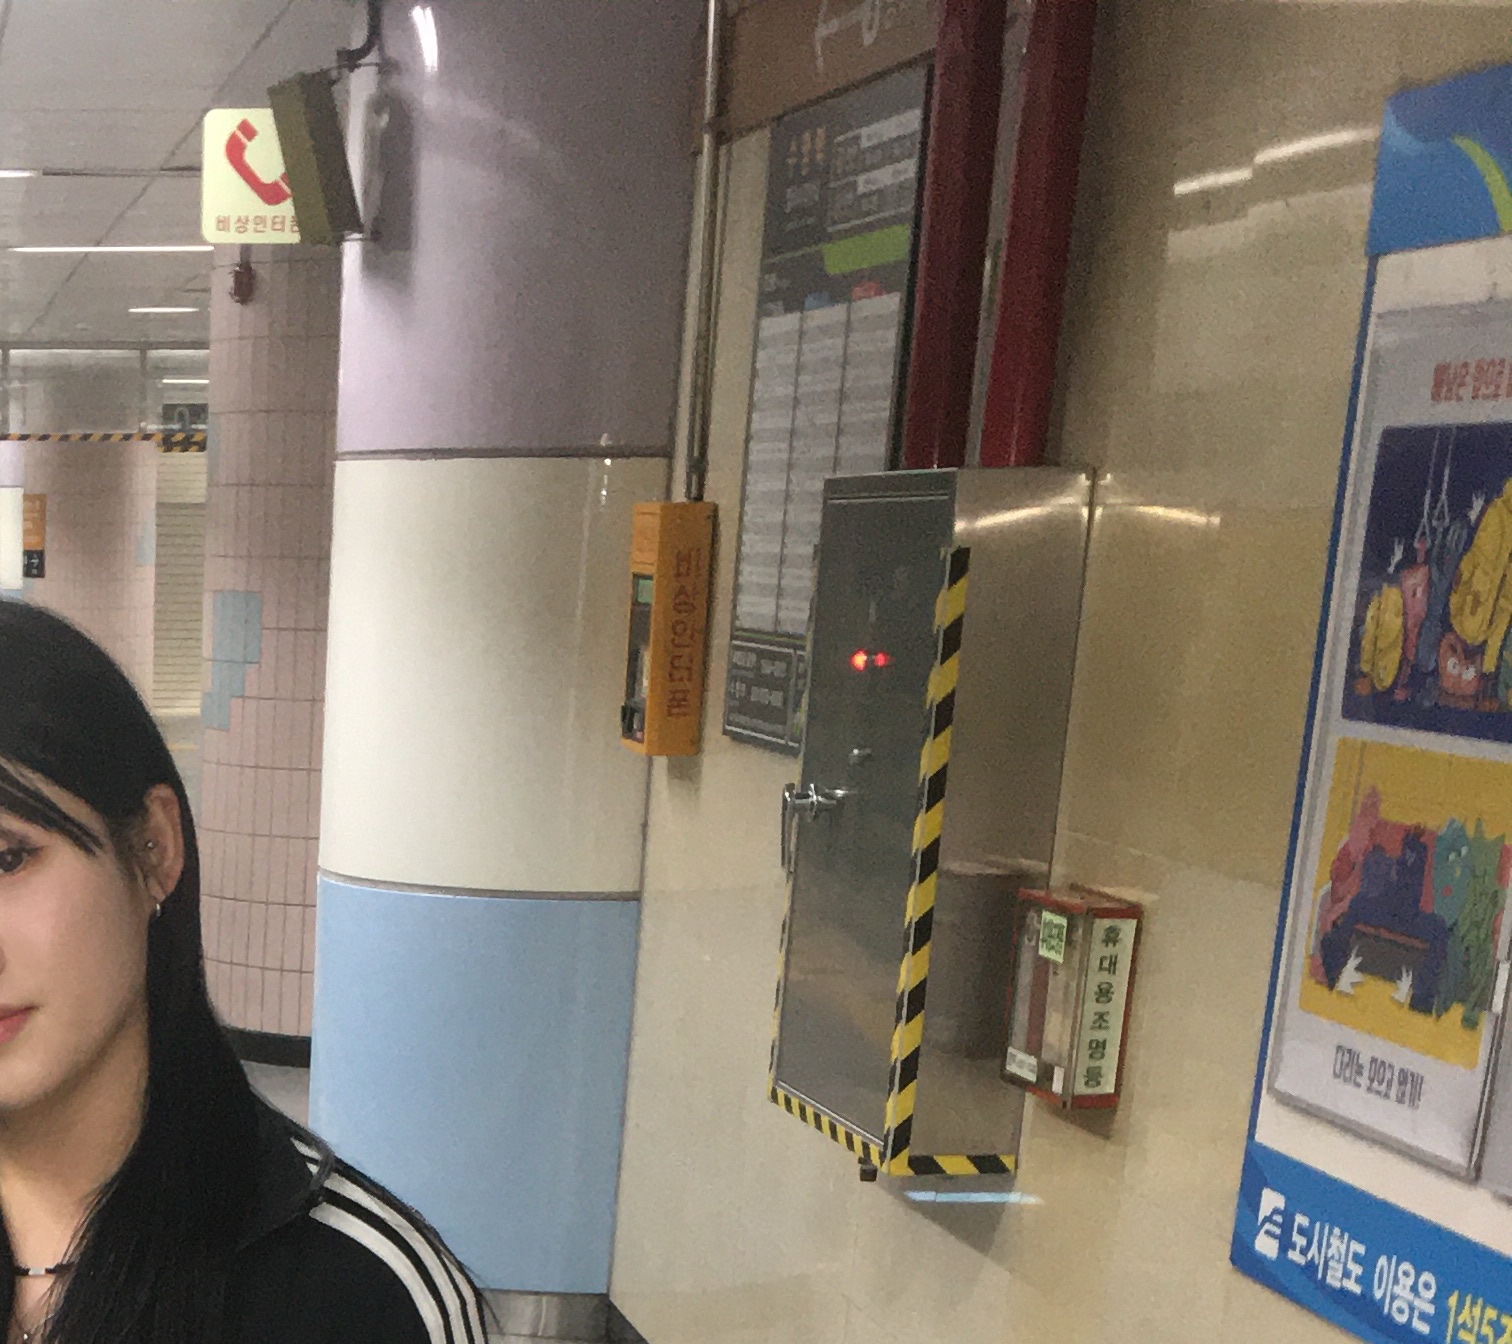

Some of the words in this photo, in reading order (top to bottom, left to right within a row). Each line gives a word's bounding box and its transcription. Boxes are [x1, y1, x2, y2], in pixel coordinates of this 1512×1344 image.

[1083, 924, 1123, 1089] 휴대용조명등
[1332, 1044, 1364, 1088] 다리는
[1366, 1055, 1395, 1100] 모으고
[1287, 1212, 1367, 1295] 도시철도
[1373, 1254, 1437, 1335] 이용은
